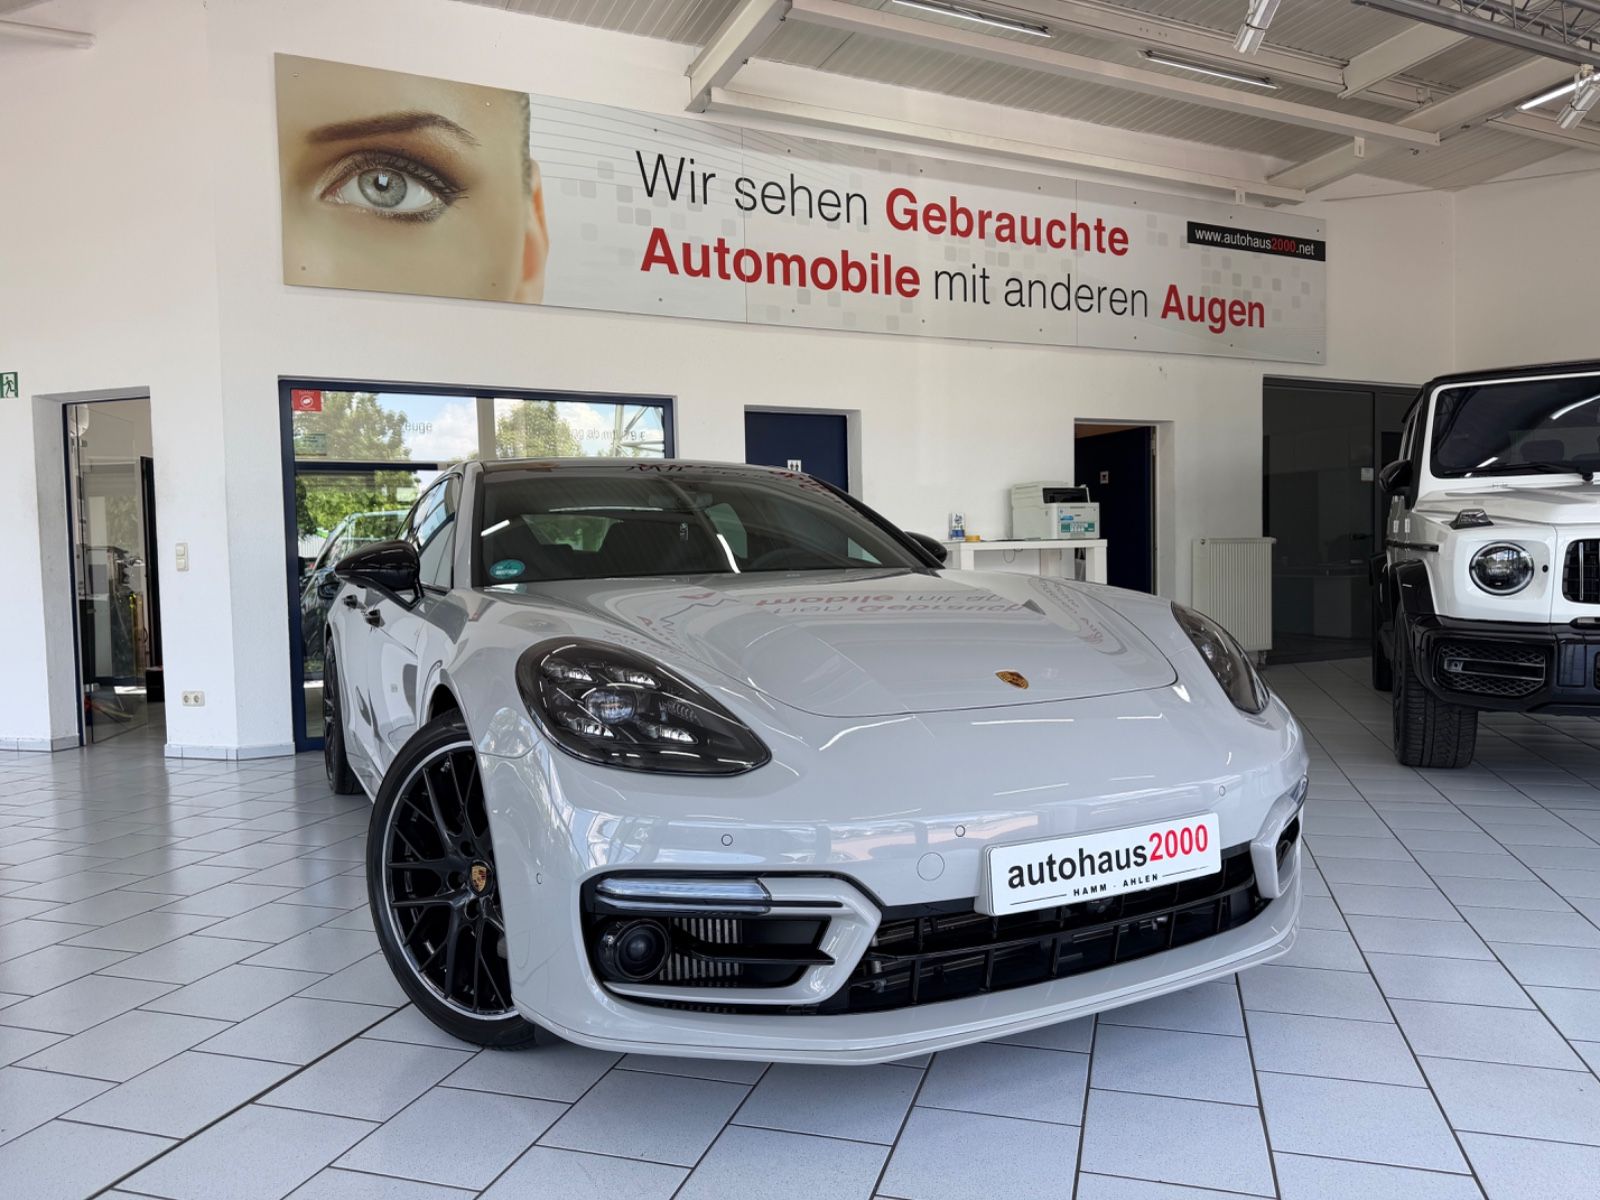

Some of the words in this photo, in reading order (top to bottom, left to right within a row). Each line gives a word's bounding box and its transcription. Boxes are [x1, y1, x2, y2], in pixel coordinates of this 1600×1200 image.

[635, 150, 717, 206] Wir
[734, 173, 869, 227] sehen
[885, 187, 1130, 257] Gebrauchte
[1194, 229, 1315, 256] www.autohaus2000.net
[641, 227, 920, 298] Automobile
[933, 265, 992, 306] mit
[1004, 273, 1150, 318] anderen
[1161, 284, 1266, 334] Augen
[1007, 824, 1208, 889] autohaus2000
[1073, 882, 1108, 897] HAMM
[1122, 873, 1159, 888] AHLEN
